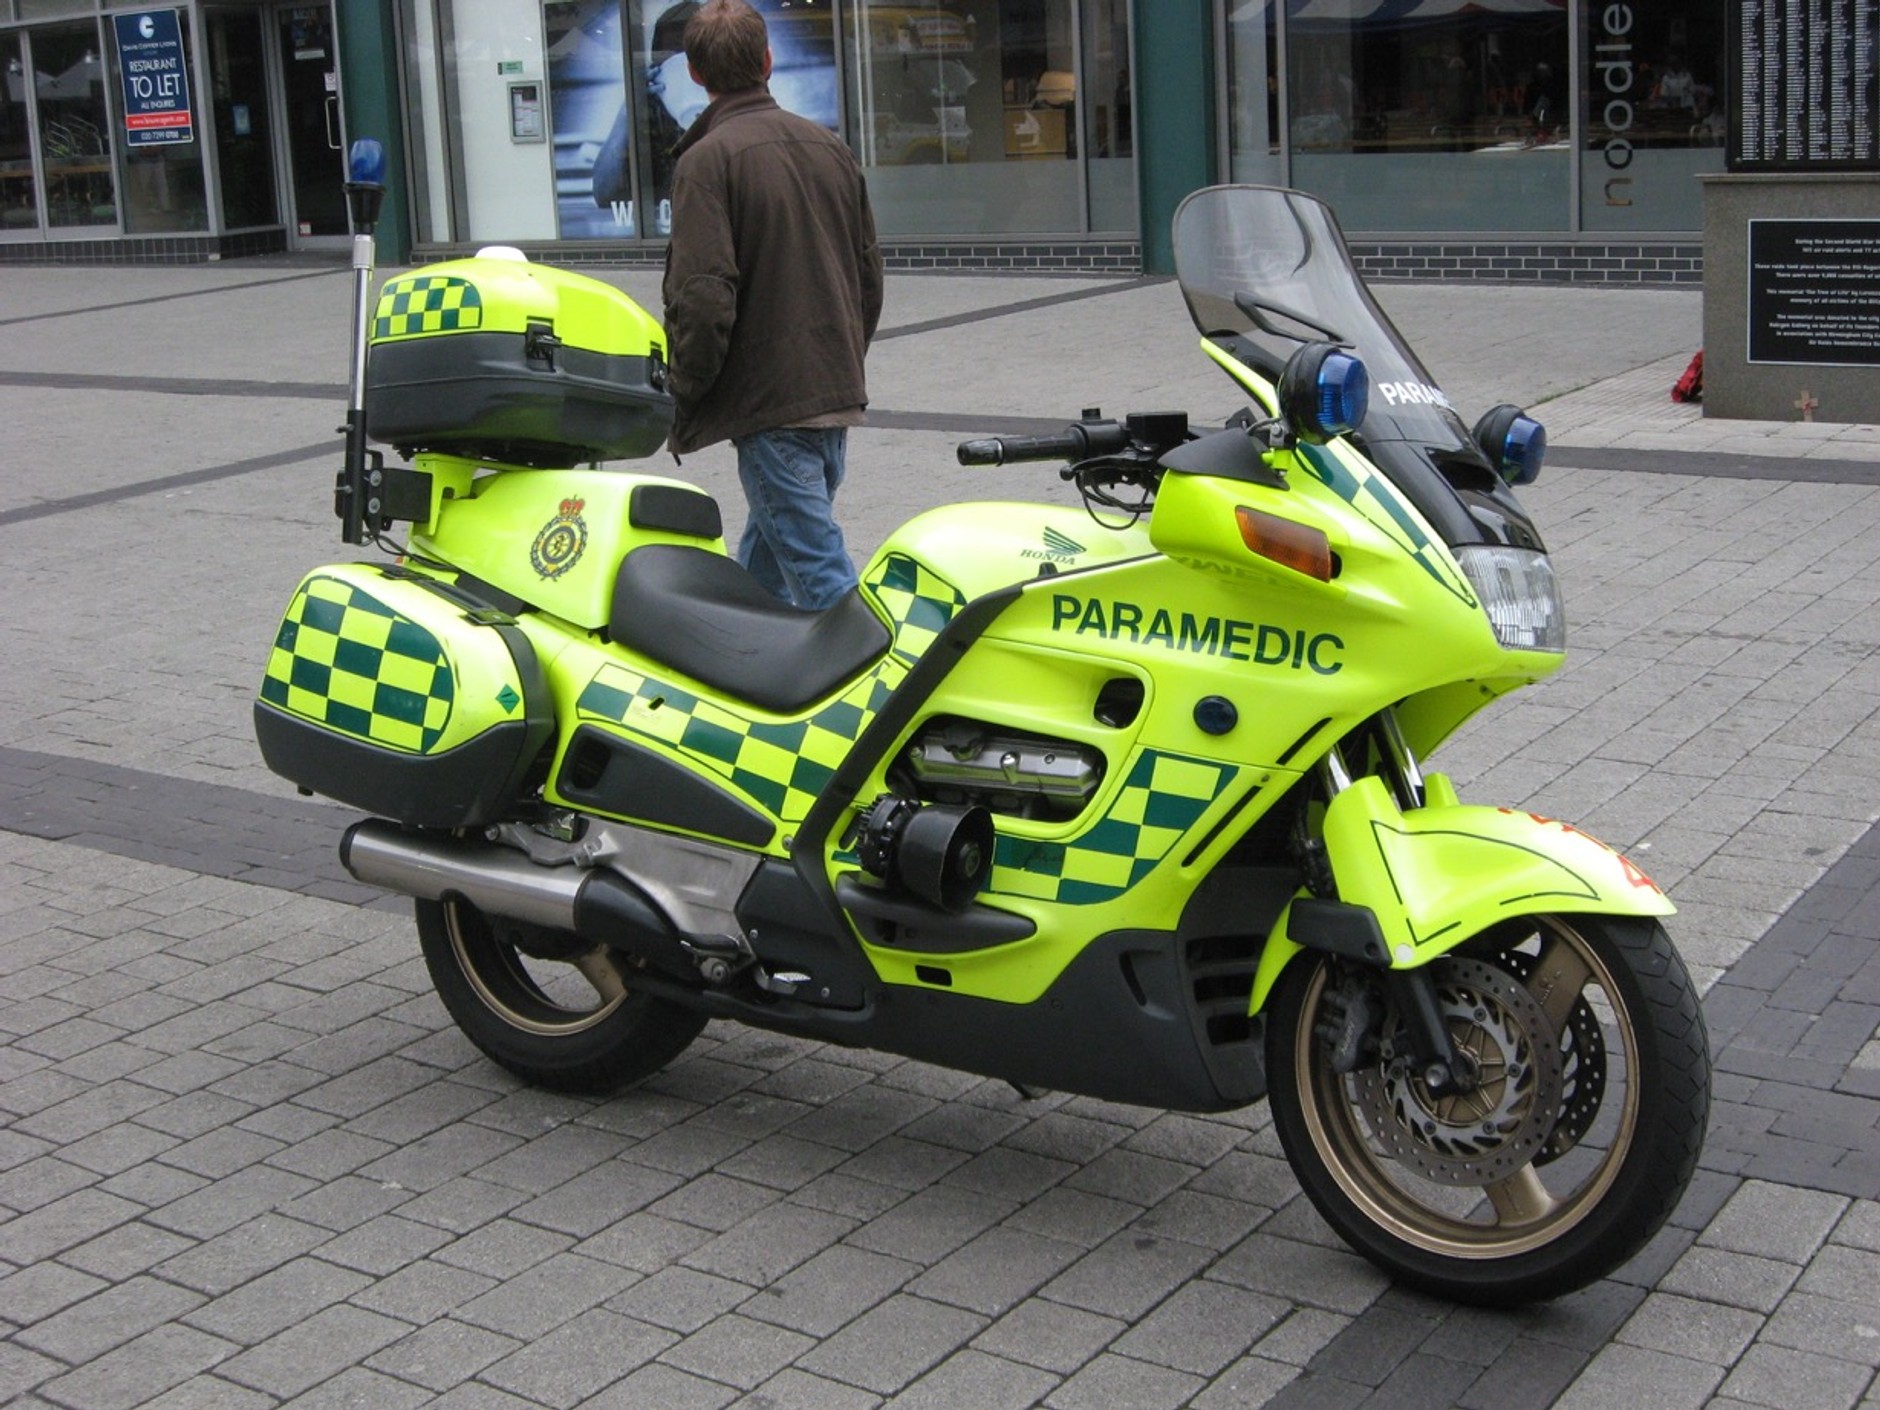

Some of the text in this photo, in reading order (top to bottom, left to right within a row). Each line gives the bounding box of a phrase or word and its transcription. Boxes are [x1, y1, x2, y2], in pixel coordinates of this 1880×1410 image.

[129, 58, 176, 72] RESTAURANT
[130, 74, 180, 98] TO LET
[1595, 4, 1633, 206] noodle
[1020, 548, 1076, 565] HONDA
[1052, 594, 1345, 675] PARAMEDIC
